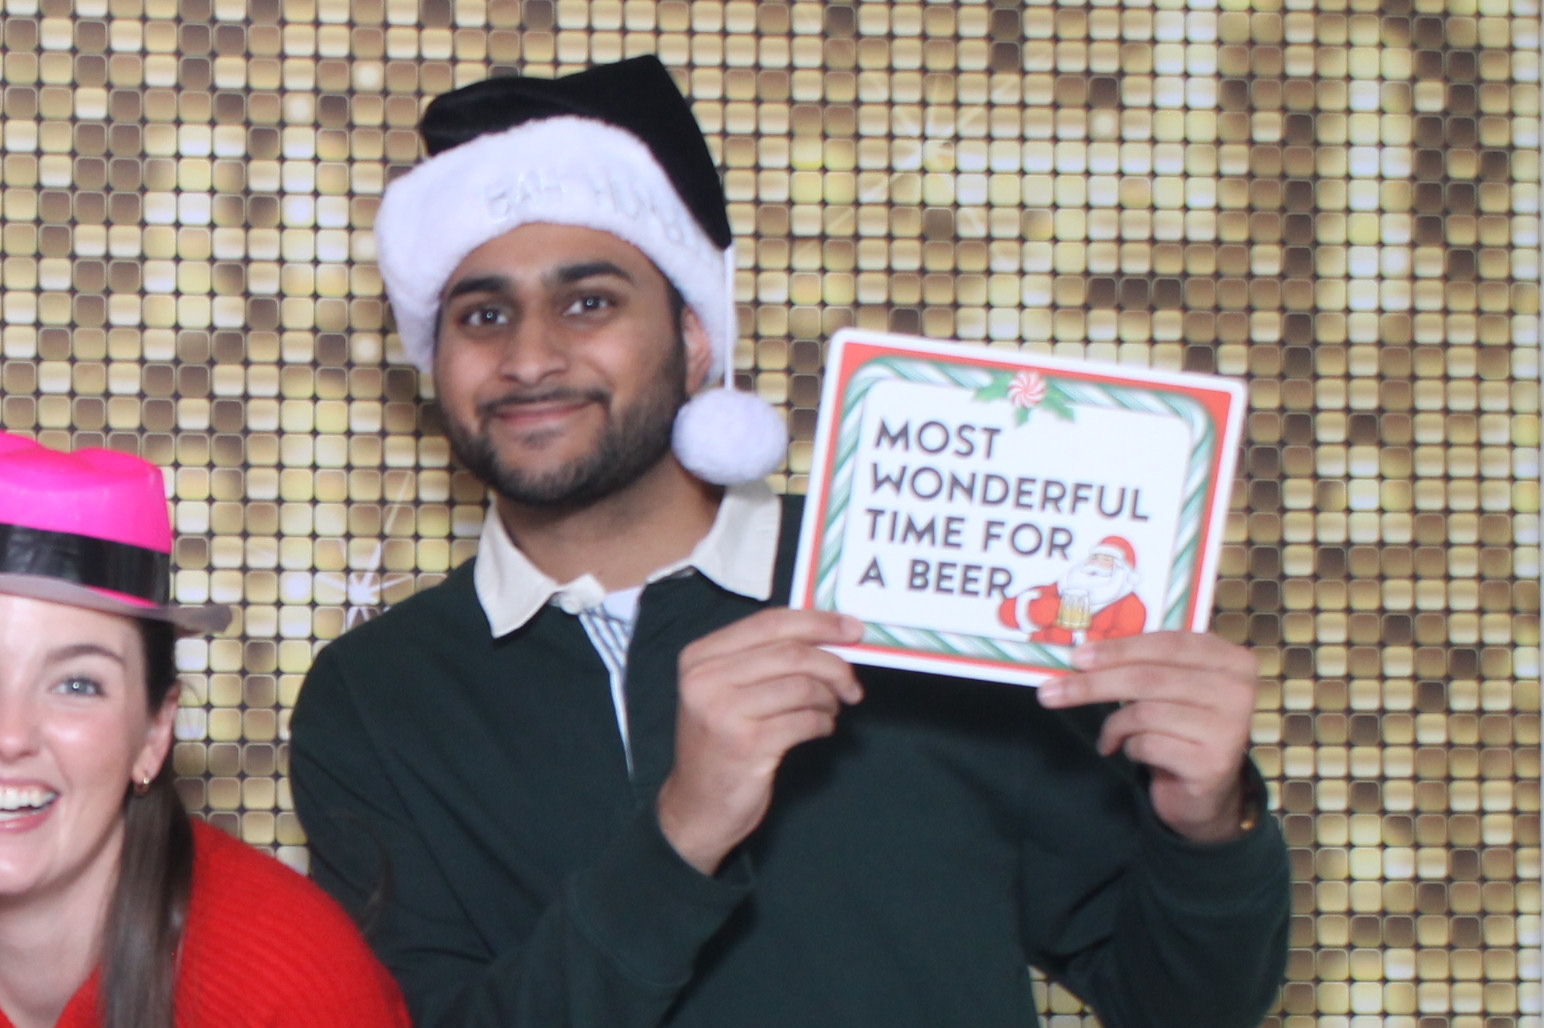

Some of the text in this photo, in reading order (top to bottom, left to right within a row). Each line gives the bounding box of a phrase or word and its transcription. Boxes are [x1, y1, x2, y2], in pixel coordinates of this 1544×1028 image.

[873, 419, 1001, 459] MOST
[870, 461, 1149, 522] WONDERFUL
[865, 507, 1075, 560] TIME FOR
[858, 556, 1014, 600] A BEER
